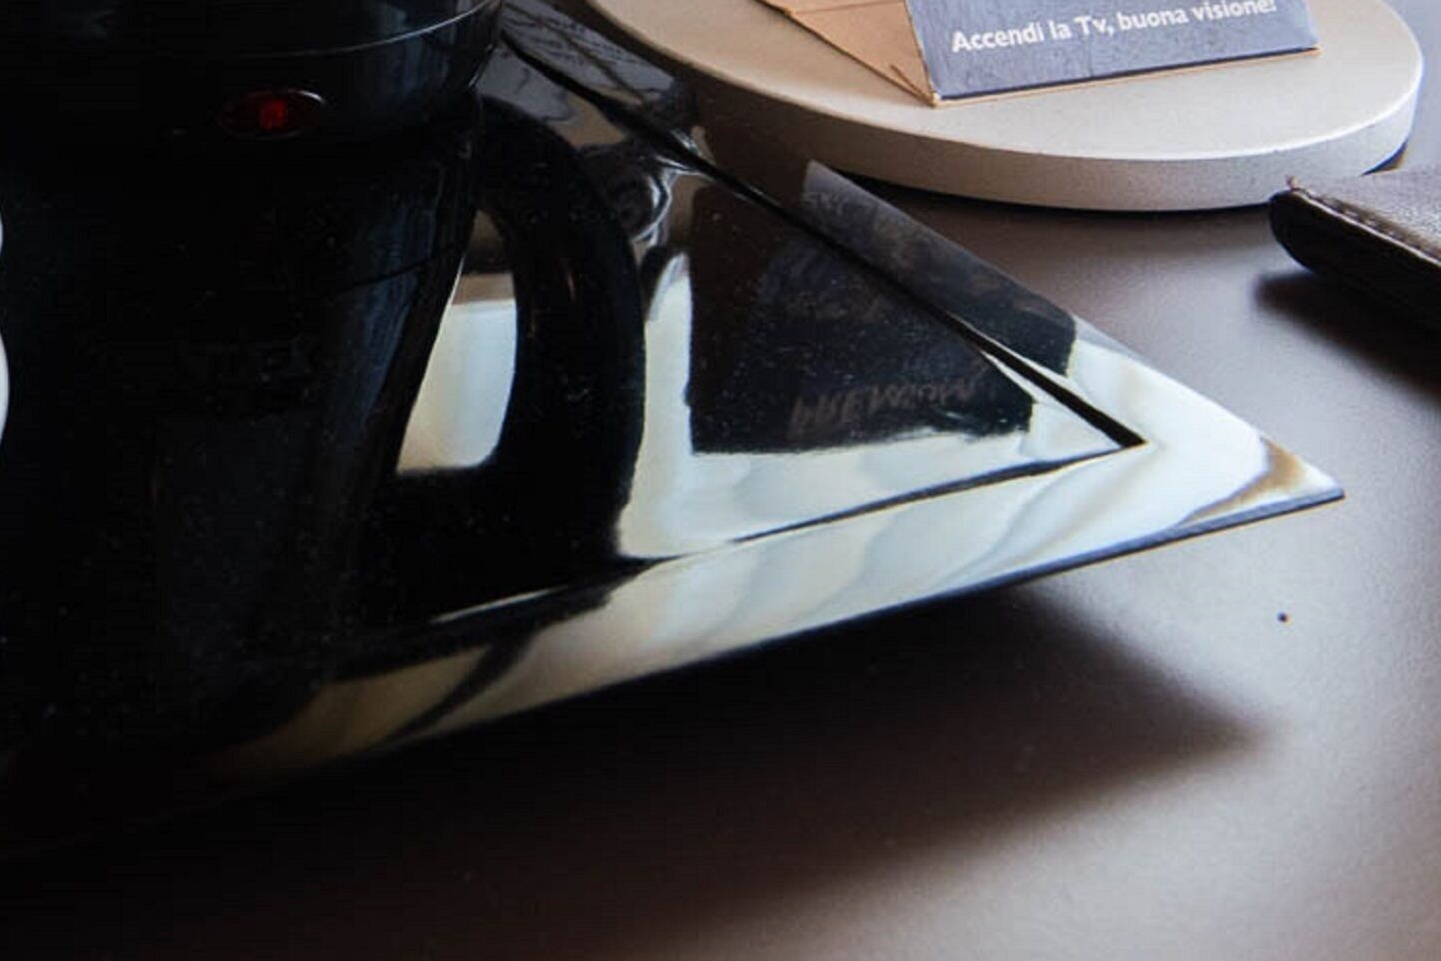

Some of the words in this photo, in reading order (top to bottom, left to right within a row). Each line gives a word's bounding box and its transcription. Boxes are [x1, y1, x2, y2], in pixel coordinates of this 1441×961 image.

[951, 21, 1045, 53] Accendi
[1049, 15, 1072, 41] la
[1075, 14, 1115, 39] Tv,
[1119, 3, 1190, 30] buona
